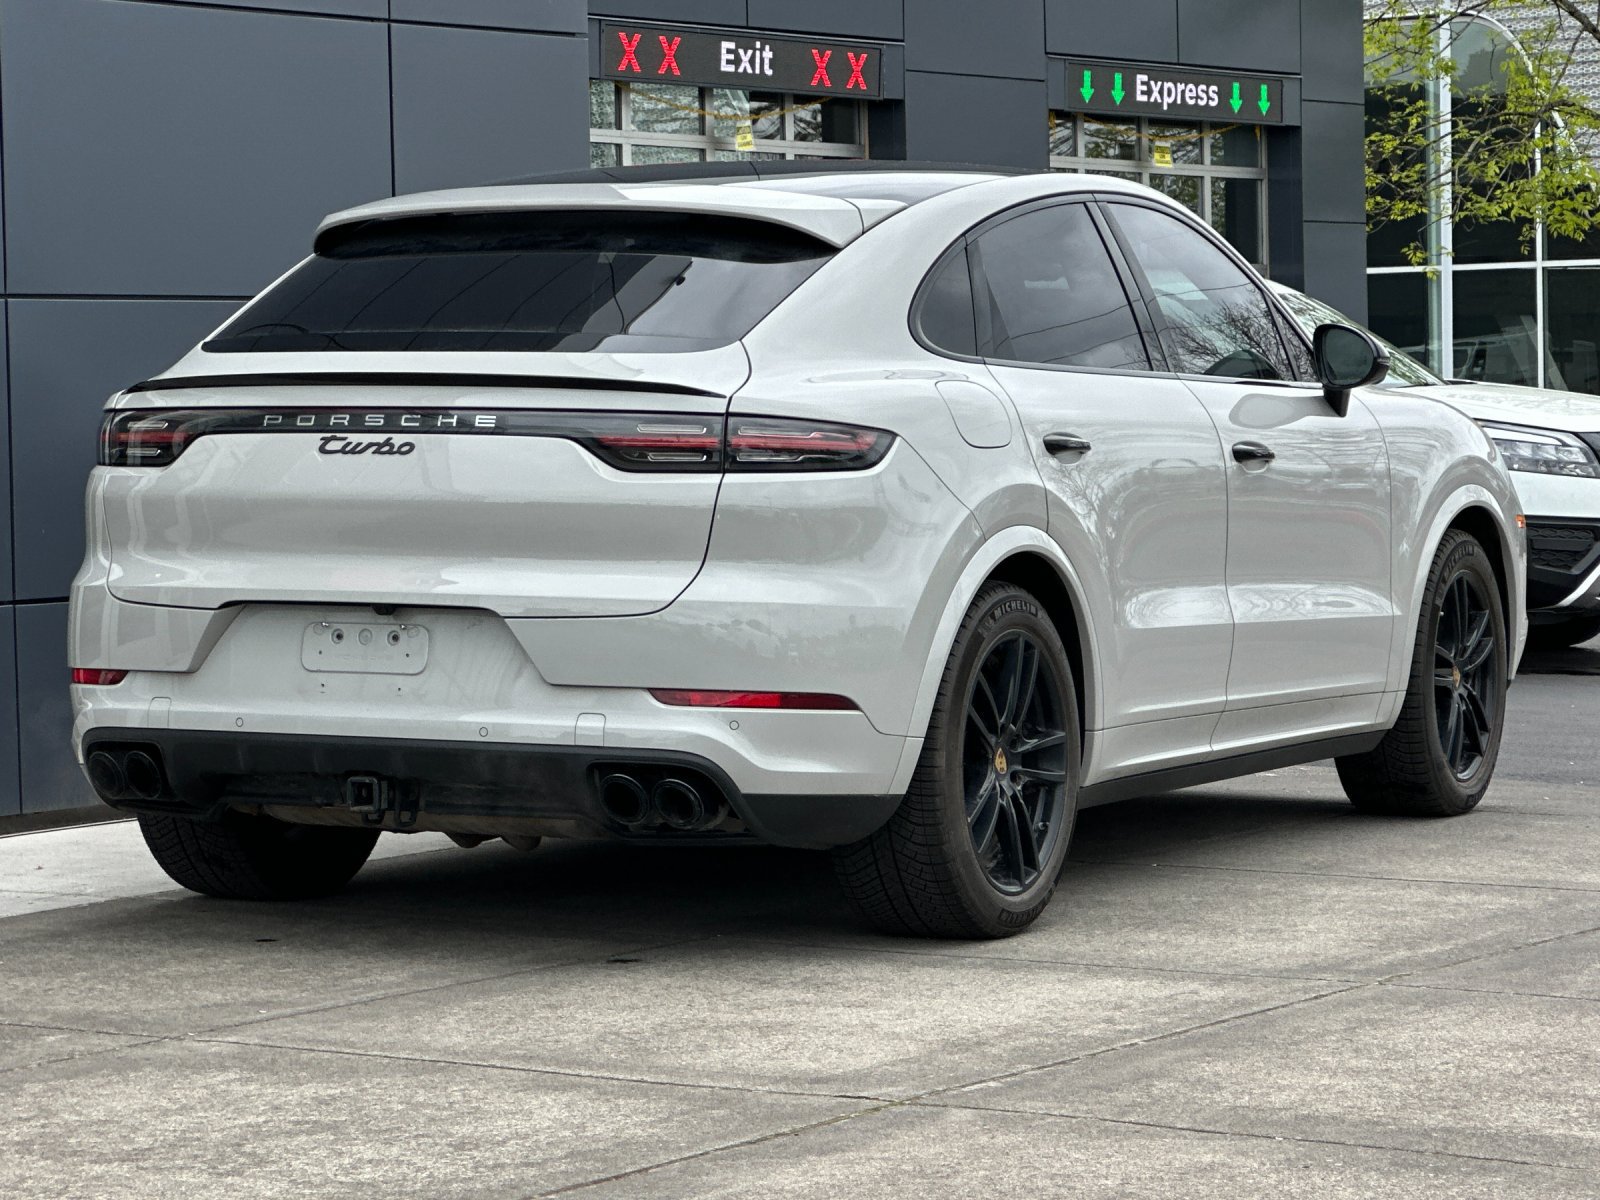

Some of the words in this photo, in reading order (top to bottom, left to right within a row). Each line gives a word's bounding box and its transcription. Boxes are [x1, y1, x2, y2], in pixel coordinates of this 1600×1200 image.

[720, 41, 773, 76] Exit
[1135, 74, 1219, 110] Express
[263, 414, 497, 427] PORSCHE
[993, 600, 1038, 619] MICHELIN
